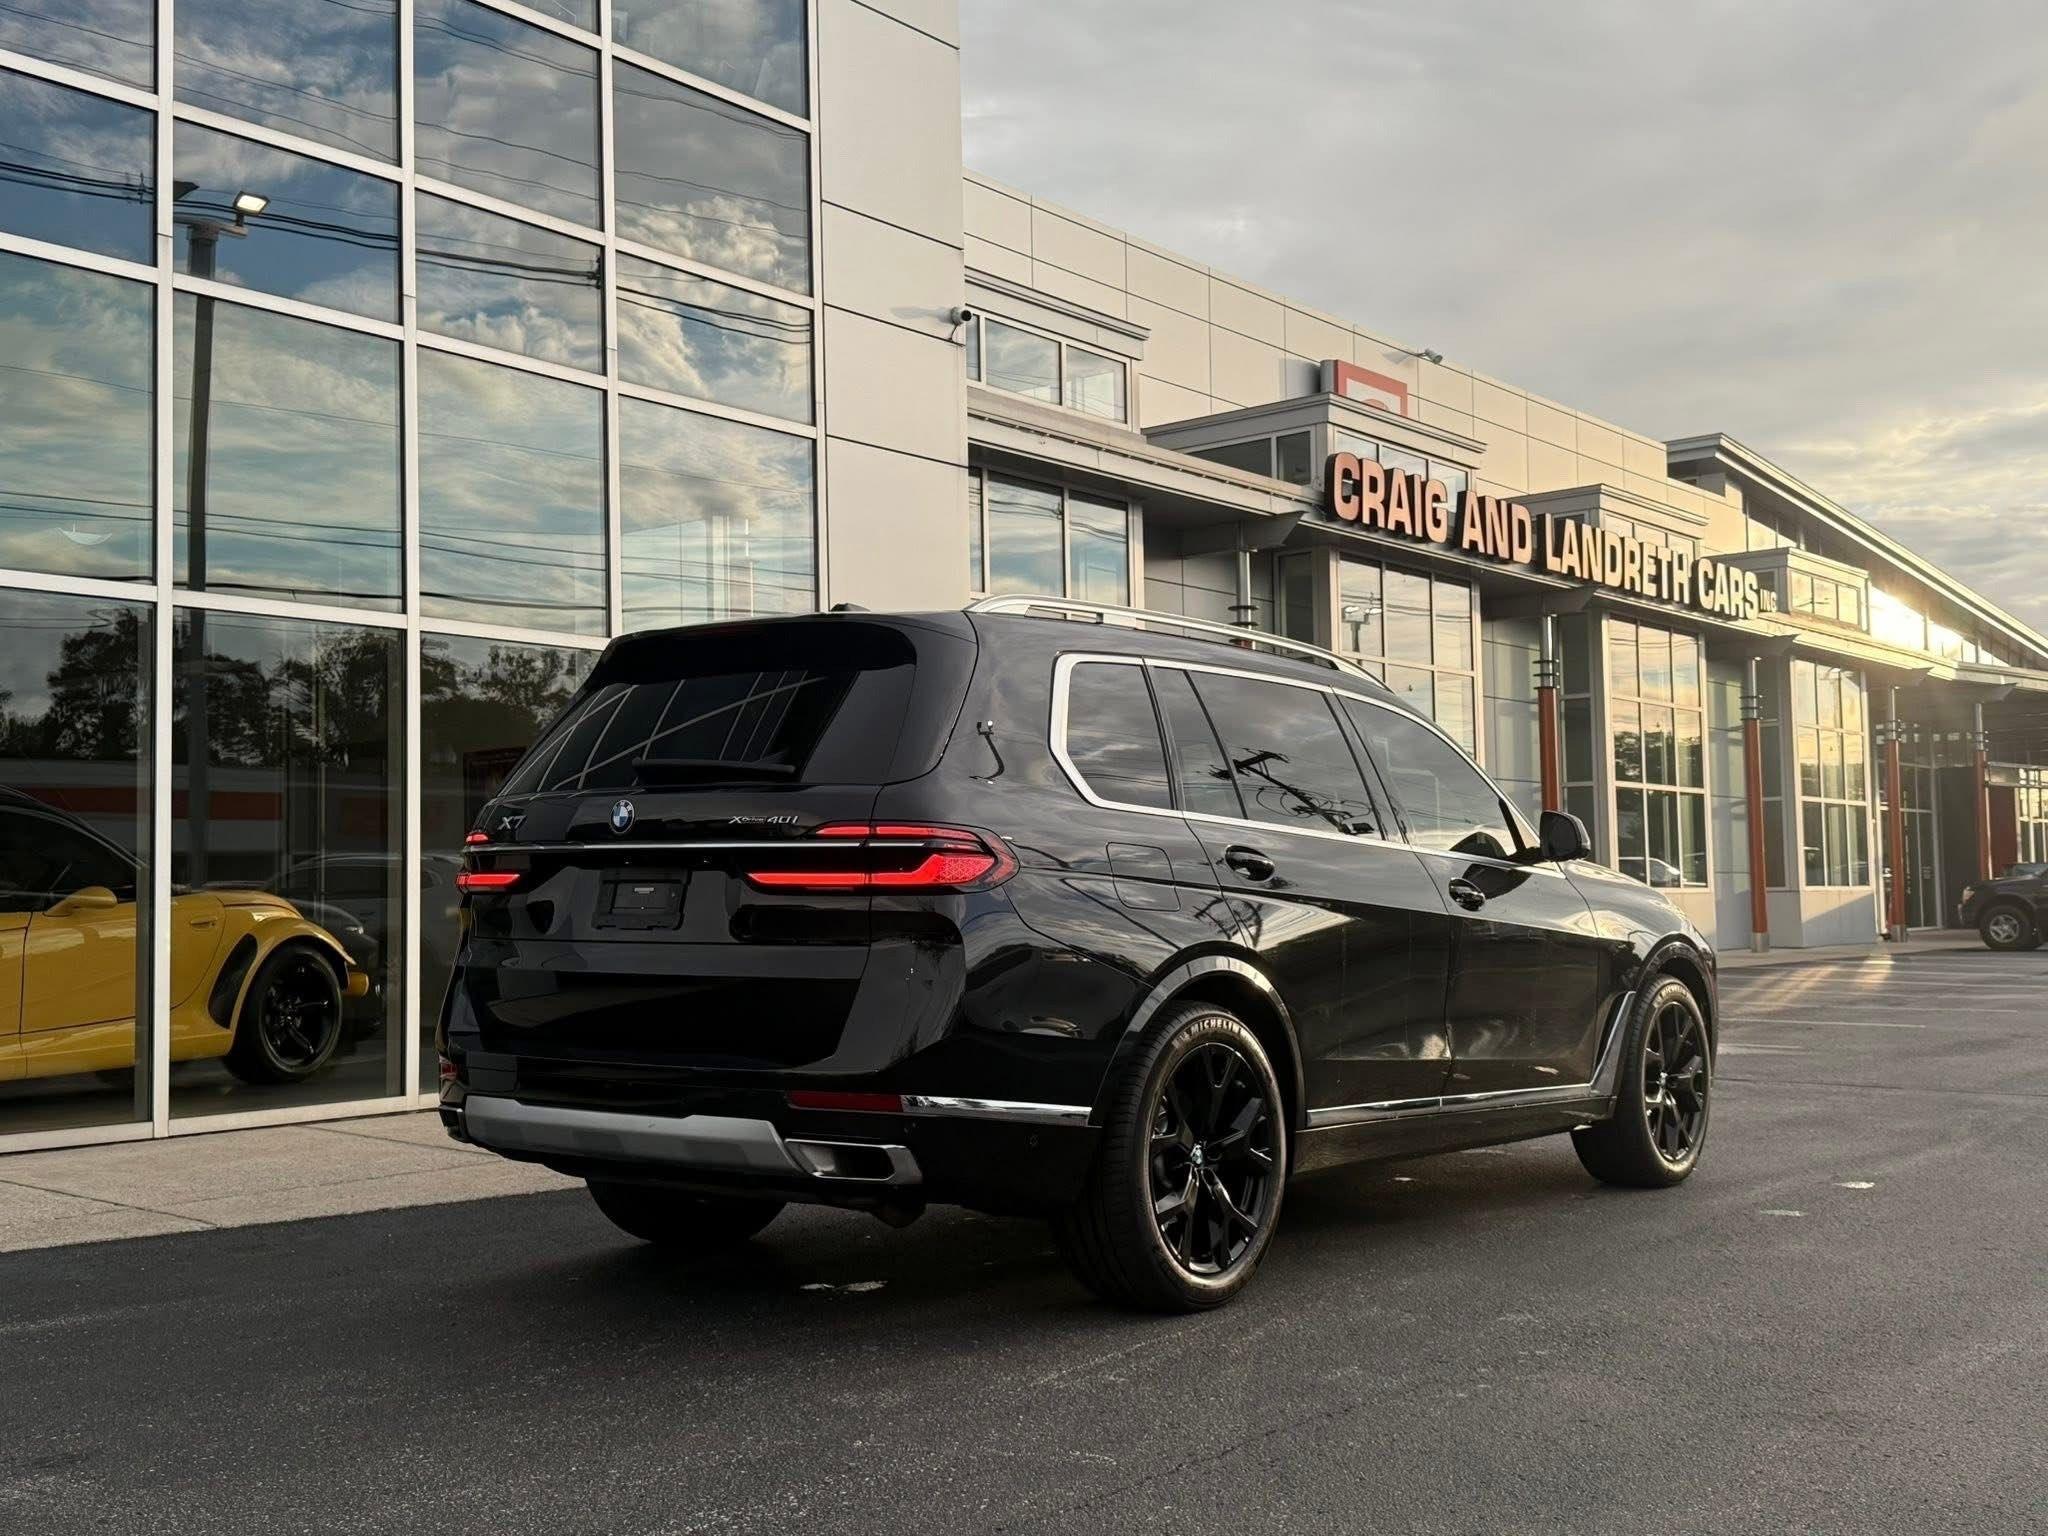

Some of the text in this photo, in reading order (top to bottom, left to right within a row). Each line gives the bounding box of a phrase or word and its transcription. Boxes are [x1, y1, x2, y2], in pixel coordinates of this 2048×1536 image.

[1332, 451, 1448, 543] CRAIG
[1461, 490, 1532, 564] AND
[1545, 512, 1691, 604] LANDRETH
[1698, 558, 1759, 620] CARS
[497, 815, 527, 830] X7
[1190, 1018, 1241, 1035] MICHELIN
